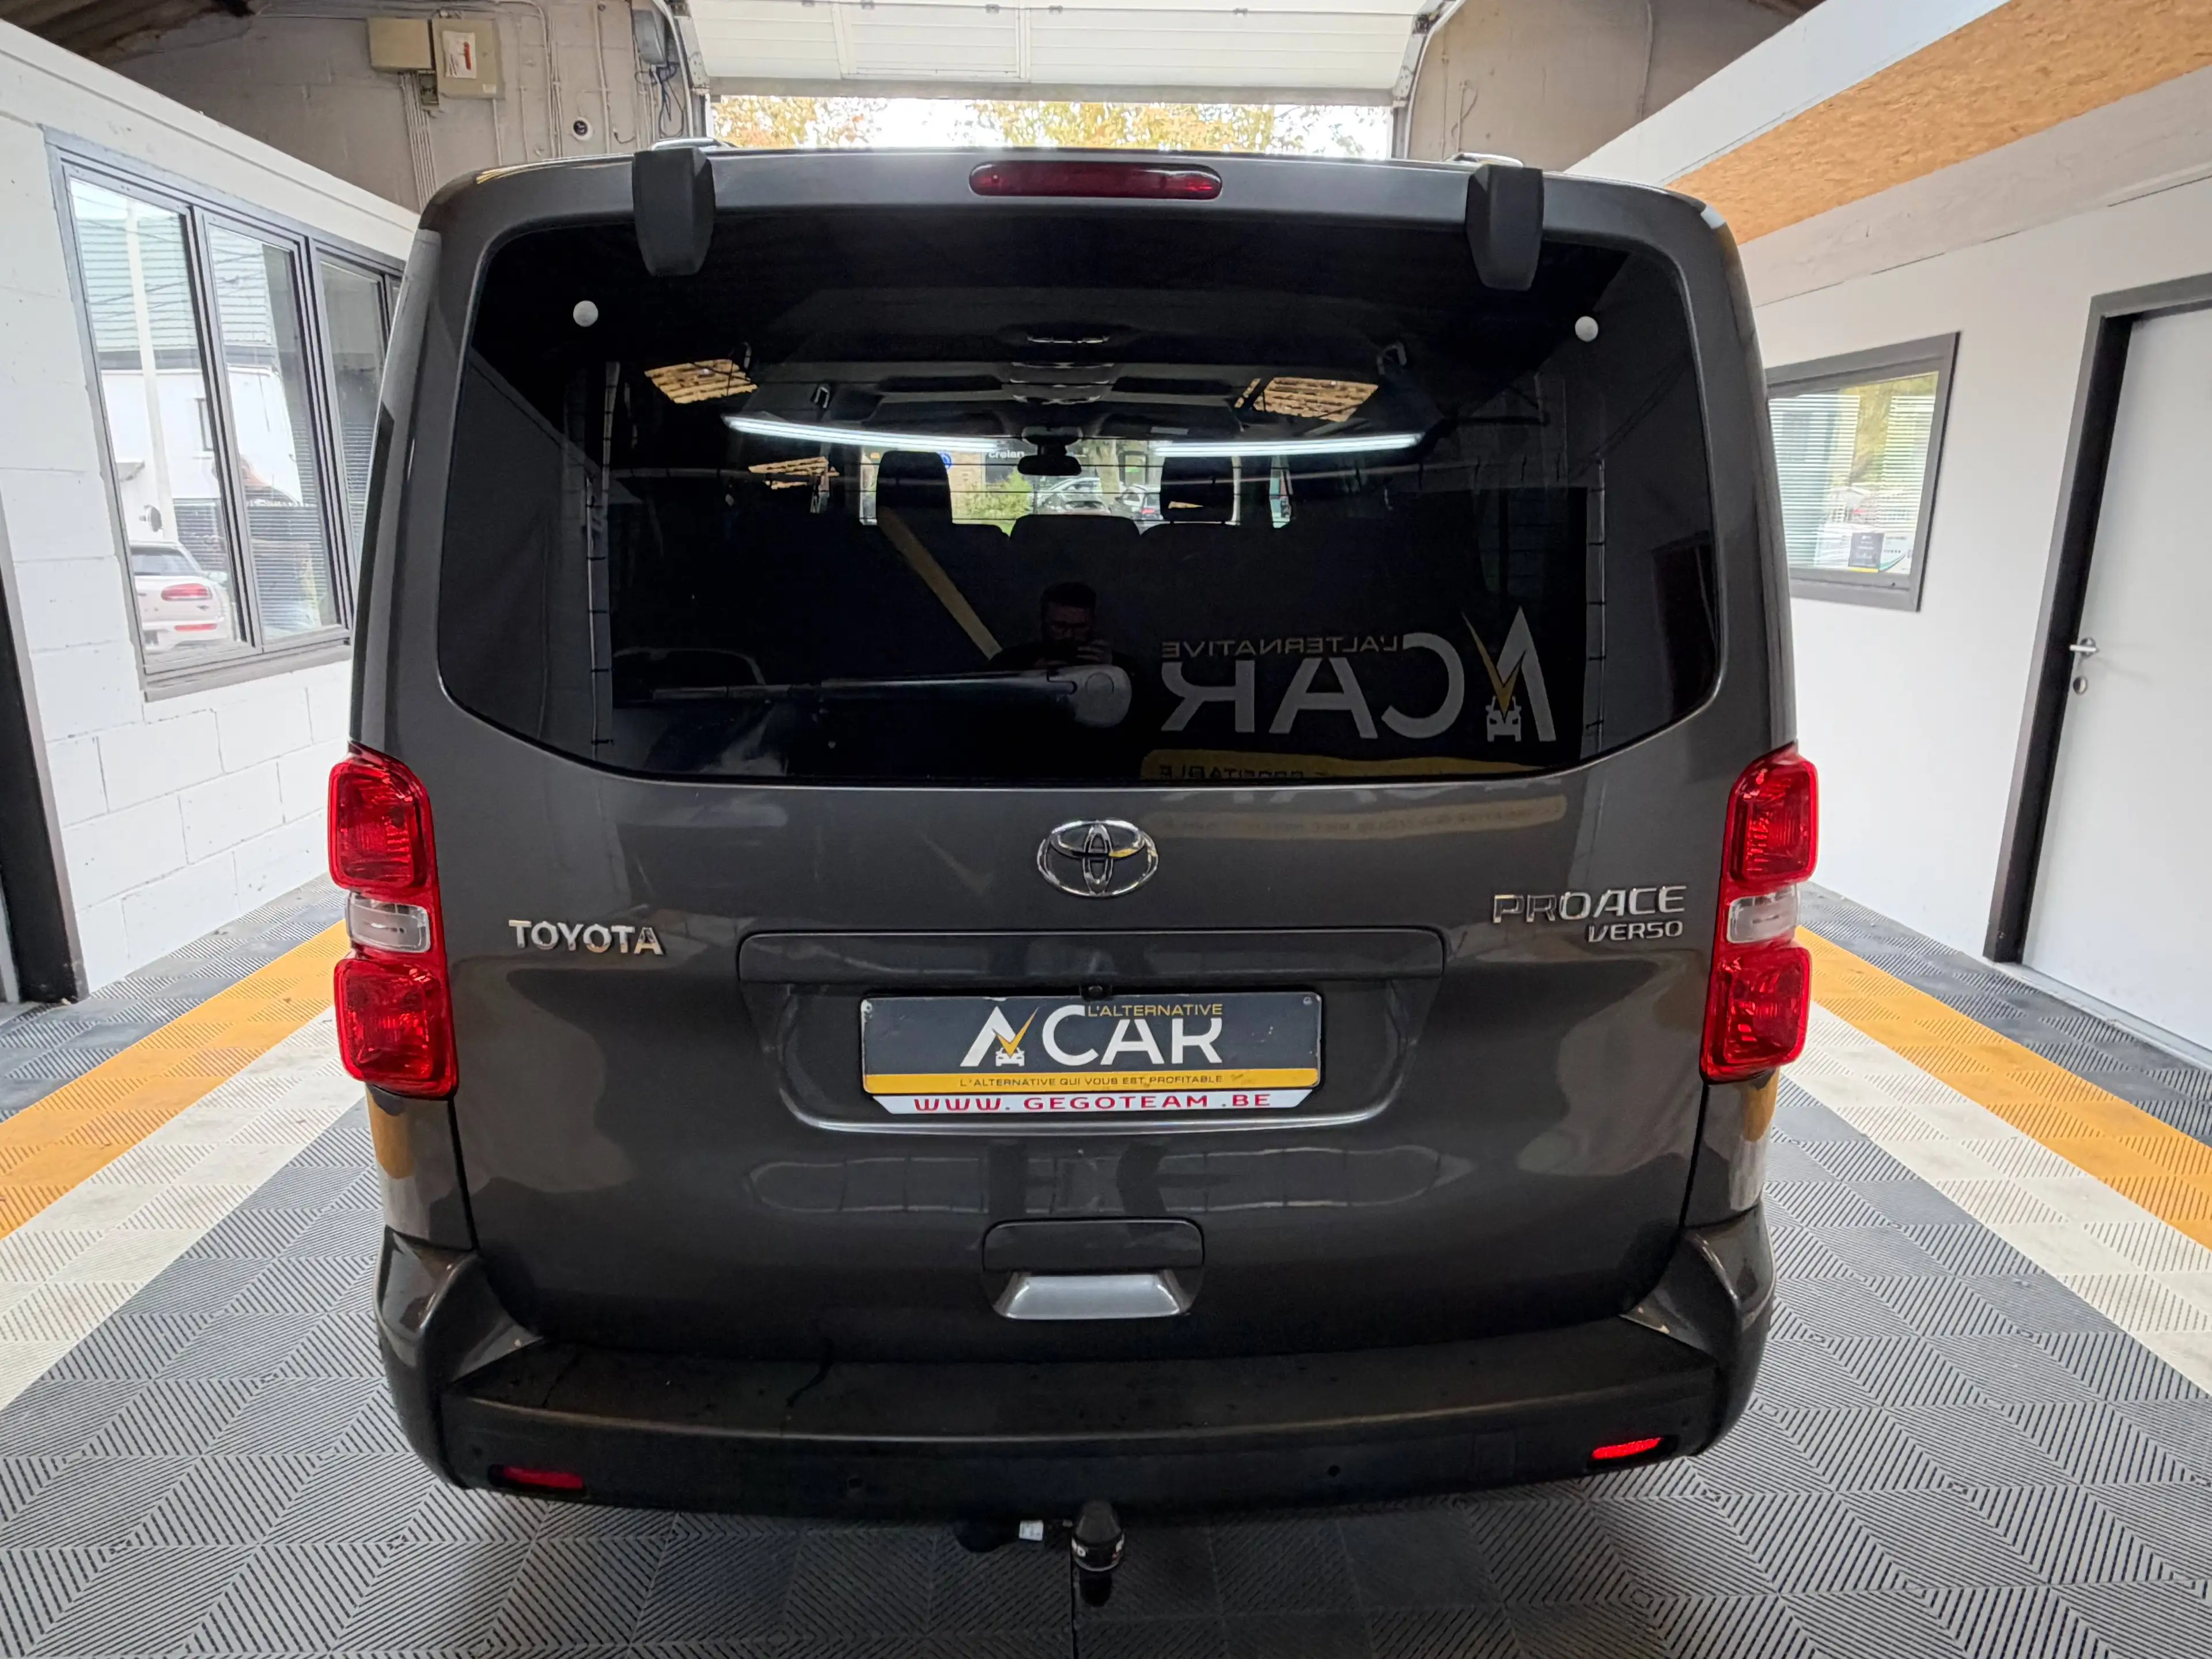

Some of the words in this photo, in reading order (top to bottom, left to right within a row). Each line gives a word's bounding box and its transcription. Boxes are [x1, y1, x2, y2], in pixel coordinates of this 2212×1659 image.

[988, 450, 1025, 459] crelan
[1493, 885, 1687, 923] PROACE
[509, 919, 664, 955] TOYOTA
[1588, 920, 1683, 943] VERSO
[1088, 1004, 1223, 1017] L'ALTERNATIVE
[960, 1078, 1056, 1087] L'ALTERNATIVE
[1060, 1077, 1080, 1086] QUI
[1085, 1077, 1118, 1085] VOUS
[1122, 1076, 1143, 1084] EST
[1150, 1074, 1222, 1084] PROFITABLE
[1024, 1095, 1208, 1110] GEGOTEAM
